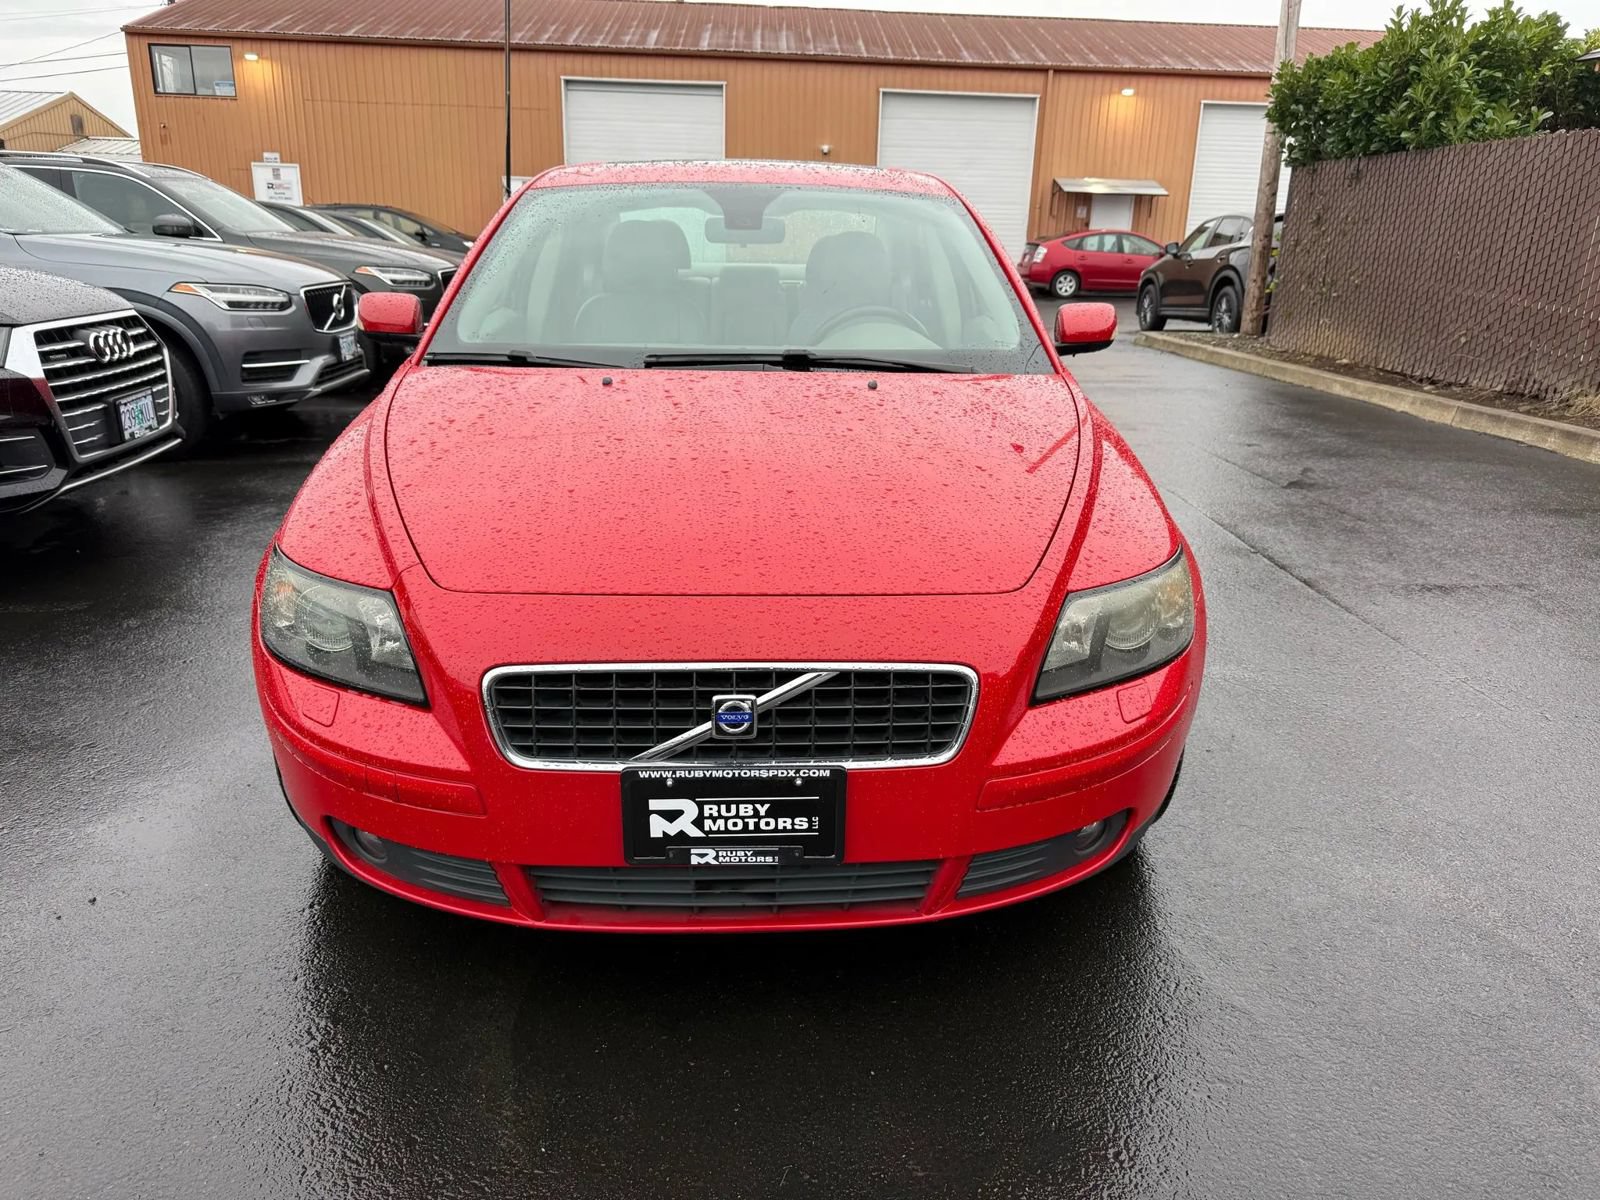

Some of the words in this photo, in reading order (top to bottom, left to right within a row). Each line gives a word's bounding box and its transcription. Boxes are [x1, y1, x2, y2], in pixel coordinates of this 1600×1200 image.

[638, 769, 831, 779] WWW.RUBYMOTORSPDX.COM
[703, 804, 771, 817] RUBY
[704, 817, 809, 831] MOTORS
